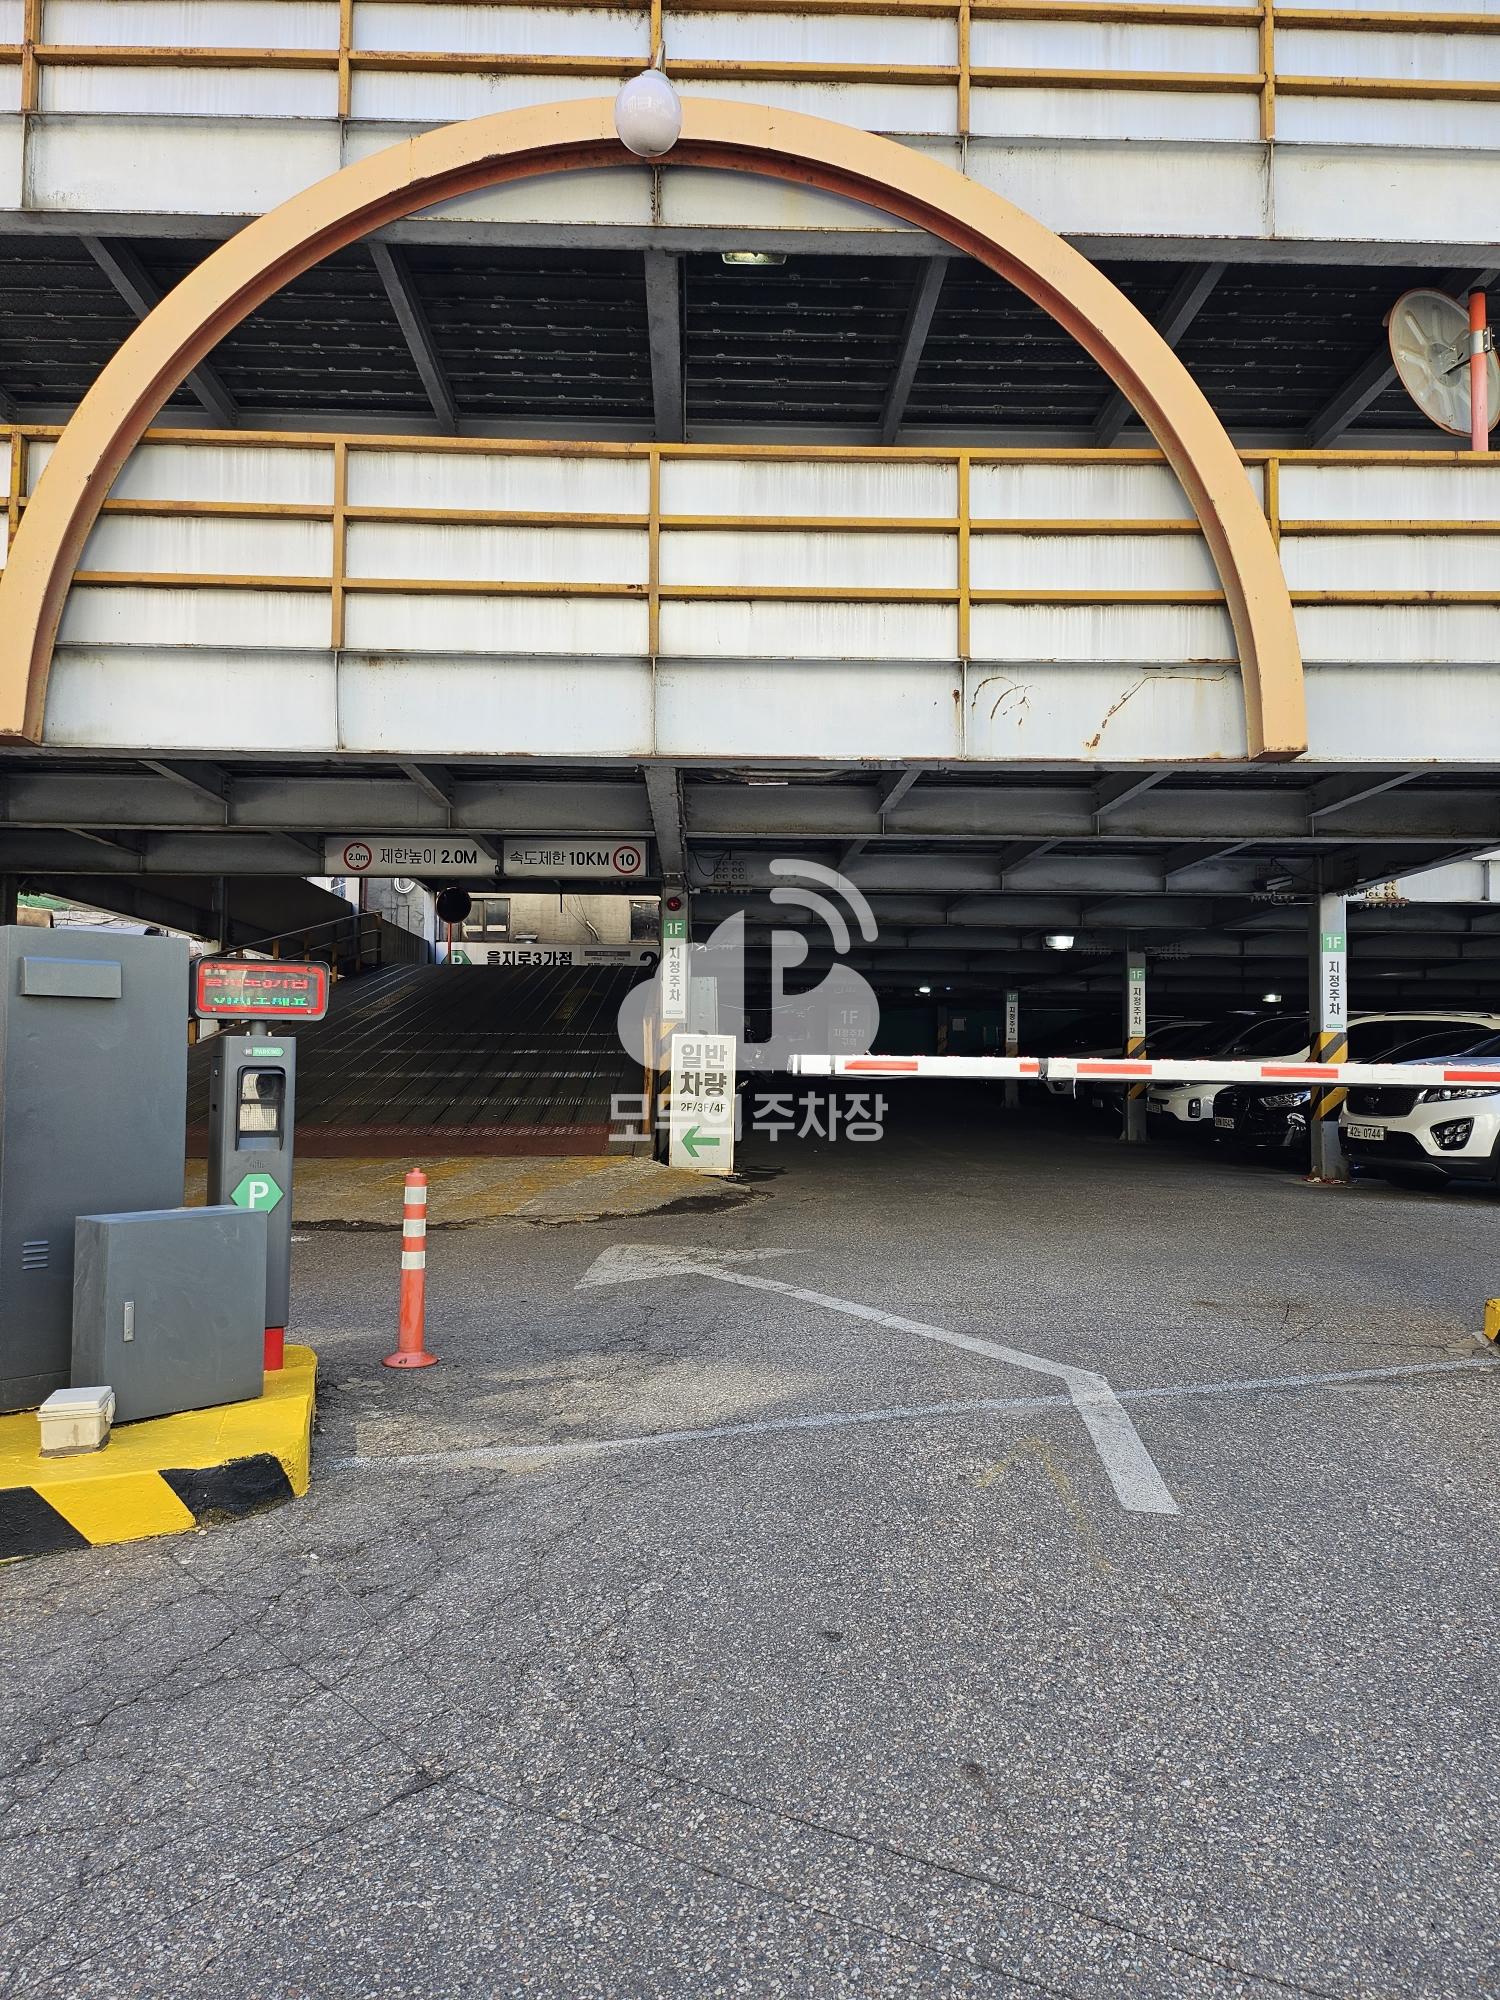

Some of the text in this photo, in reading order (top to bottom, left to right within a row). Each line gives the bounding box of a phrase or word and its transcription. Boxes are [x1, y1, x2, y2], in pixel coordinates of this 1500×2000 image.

[348, 848, 477, 865] 2.0m 제한높이 2.0M
[509, 850, 635, 866] 속도제한 10KM 10
[667, 922, 682, 935] 1F
[1326, 936, 1342, 949] 1F
[669, 946, 681, 1001] 지정주차
[1131, 970, 1143, 979] 1F
[1329, 961, 1341, 1015] 지정주차
[1133, 987, 1141, 1025] 지정주차
[840, 1010, 858, 1024] 1F
[681, 1043, 728, 1069] 일반
[680, 1071, 728, 1097] 차량
[680, 1102, 727, 1113] 2F/3F/4F
[249, 1181, 270, 1209] P
